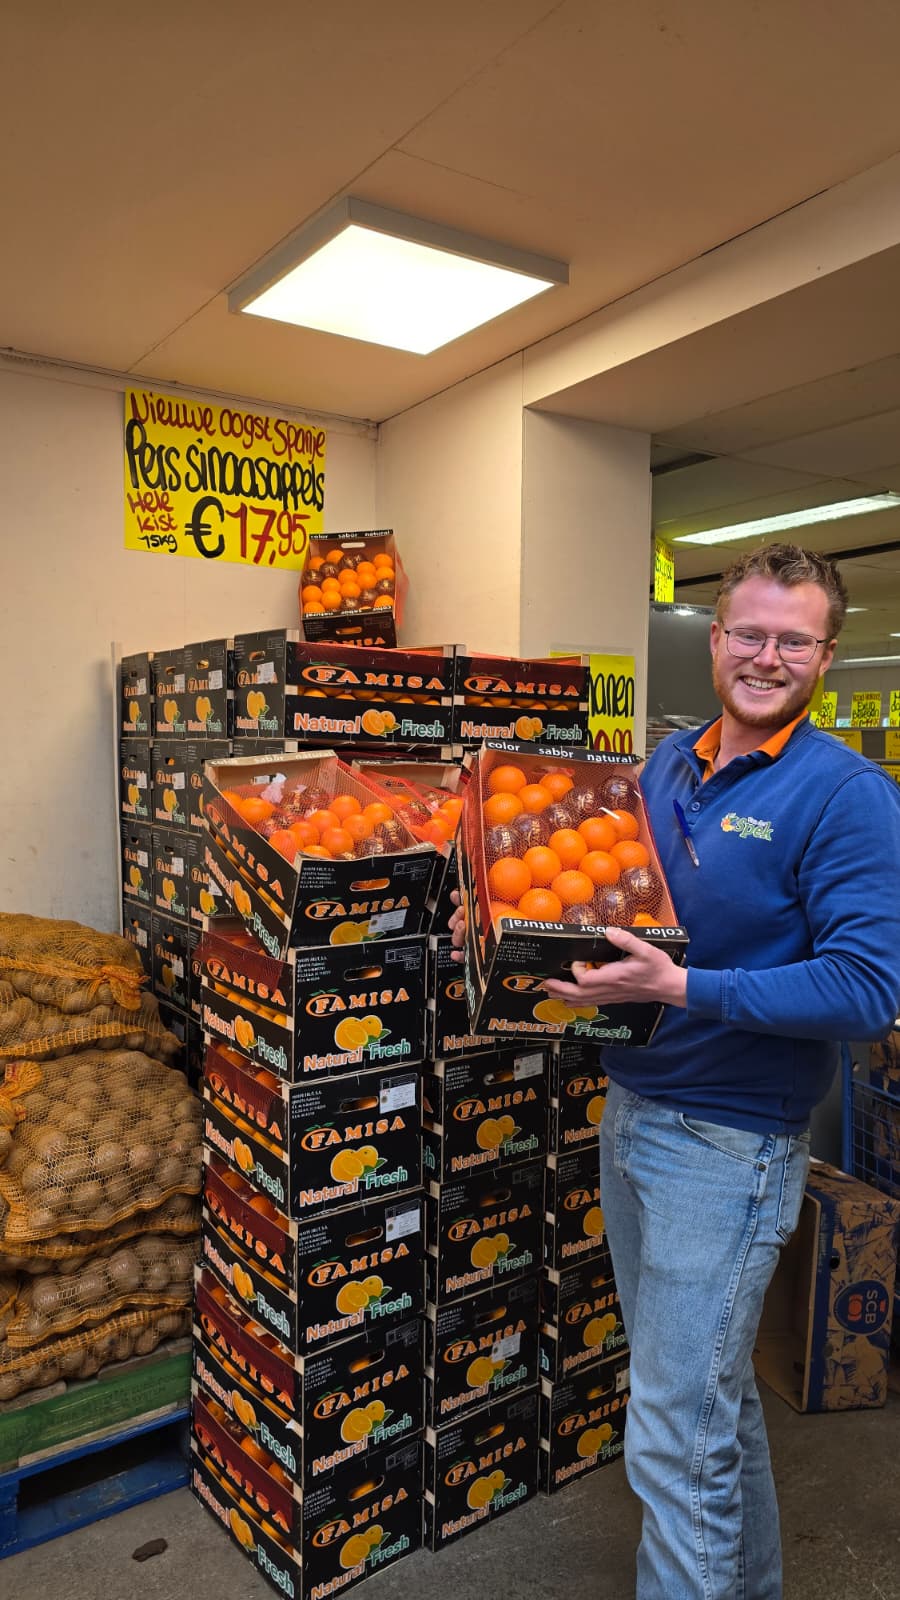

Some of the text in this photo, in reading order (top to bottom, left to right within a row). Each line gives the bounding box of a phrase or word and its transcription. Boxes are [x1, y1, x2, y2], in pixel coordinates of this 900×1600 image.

[130, 392, 216, 436] Nieuwe
[272, 420, 325, 464] Spanje
[127, 490, 174, 513] Hele
[315, 668, 445, 690] FAMISA
[475, 679, 579, 696] FAMISA
[294, 712, 445, 737] Natural Fresh
[460, 721, 515, 739] Natural
[546, 724, 583, 741] Fresh
[488, 741, 633, 764] color sabor natural
[314, 895, 410, 918] FAMISA
[508, 918, 564, 931] natural
[252, 912, 281, 960] Fresh
[645, 926, 684, 937] color
[211, 961, 286, 1006] FAMISA
[315, 987, 410, 1013] FAMISA
[203, 1005, 288, 1071] Natural Fresh
[488, 1018, 632, 1039] Natural Fresh
[303, 1038, 411, 1072] Natural Fresh
[213, 1077, 282, 1141] FAMISA
[461, 1087, 537, 1117] FAMISA
[311, 1115, 406, 1149] FAMISA
[451, 1135, 539, 1172] Natural Fresh
[256, 1162, 285, 1204] Fresh
[299, 1166, 408, 1207] Natural Fresh
[208, 1193, 286, 1275] FAMISA
[456, 1203, 532, 1238] FAMISA
[316, 1242, 410, 1284] FAMISA
[446, 1251, 533, 1291] Natural Fresh
[257, 1292, 291, 1338] Fresh
[306, 1292, 412, 1344] Natural Fresh
[202, 1317, 295, 1412] FAMISA
[321, 1364, 410, 1416] FAMISA
[440, 1364, 527, 1414] Natural Fresh
[260, 1421, 296, 1474] Fresh
[312, 1435, 369, 1476] Natural
[373, 1413, 412, 1445] Fresh
[451, 1436, 527, 1483] FAMISA
[197, 1425, 291, 1534] FAMISA
[319, 1487, 409, 1545] FAMISA
[441, 1482, 528, 1539] Natural Fresh
[257, 1543, 295, 1599] Fresh
[310, 1533, 410, 1600] Natural Fresh
